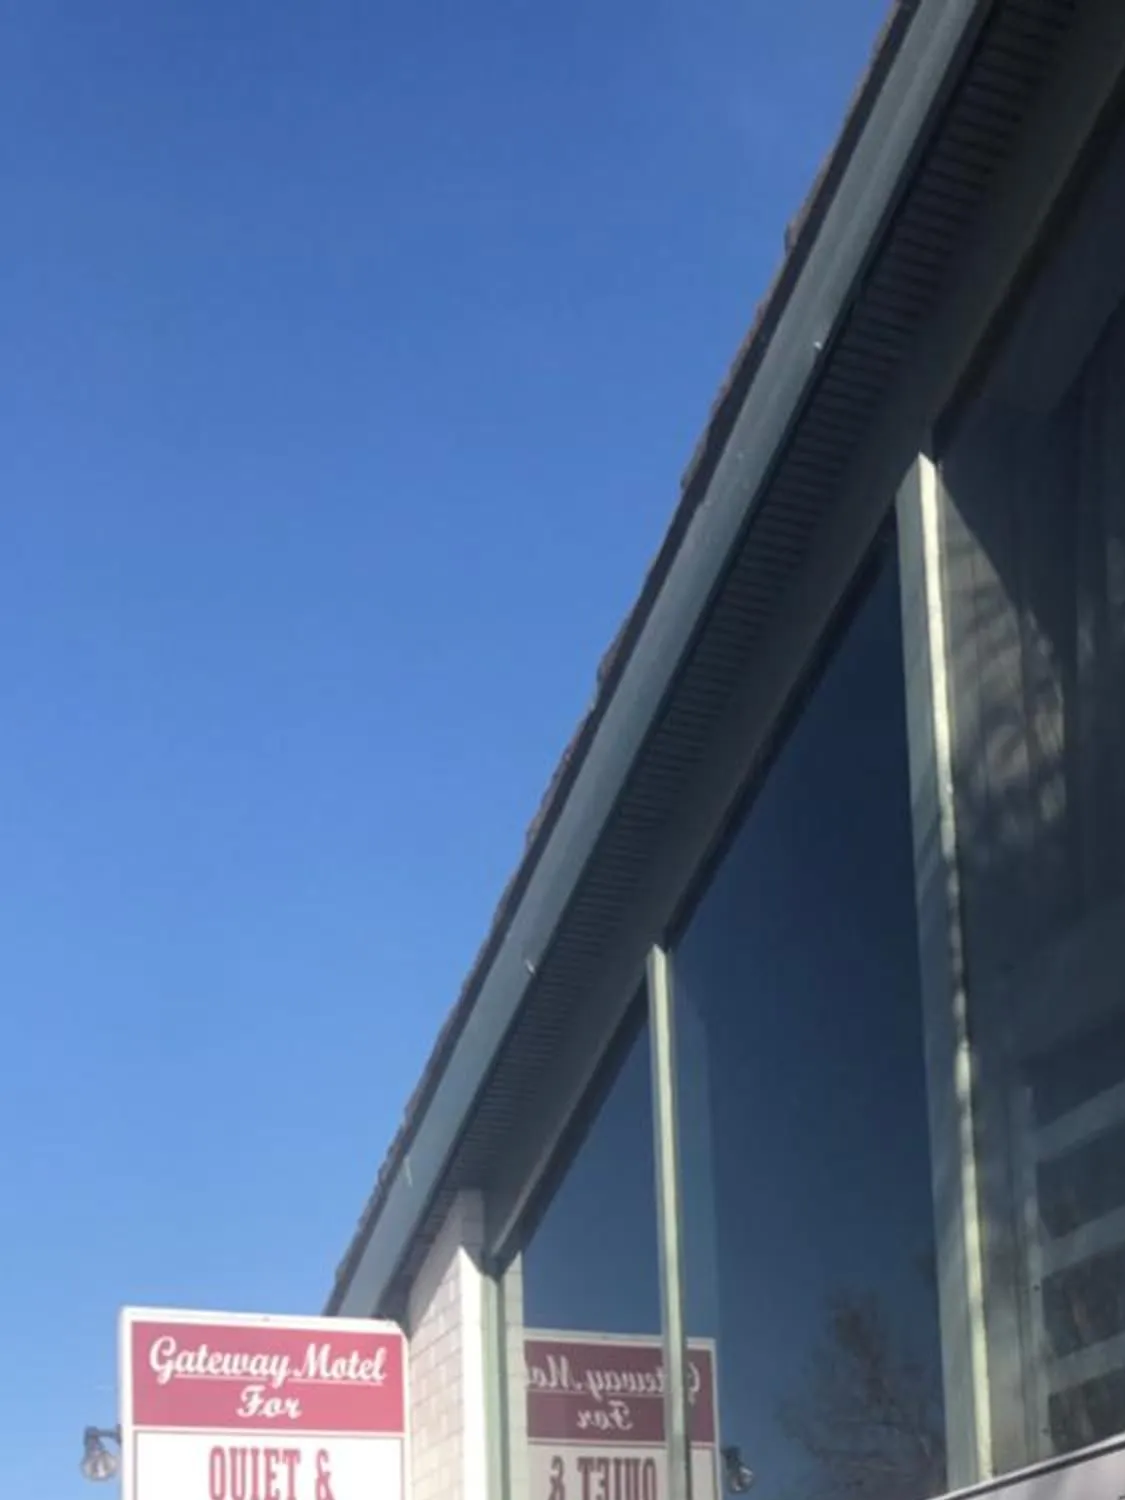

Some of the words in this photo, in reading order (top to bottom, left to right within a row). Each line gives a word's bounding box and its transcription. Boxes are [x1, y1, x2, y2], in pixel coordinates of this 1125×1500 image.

[149, 1335, 291, 1389] Gateway
[293, 1343, 387, 1382] Motel
[236, 1384, 303, 1419] For
